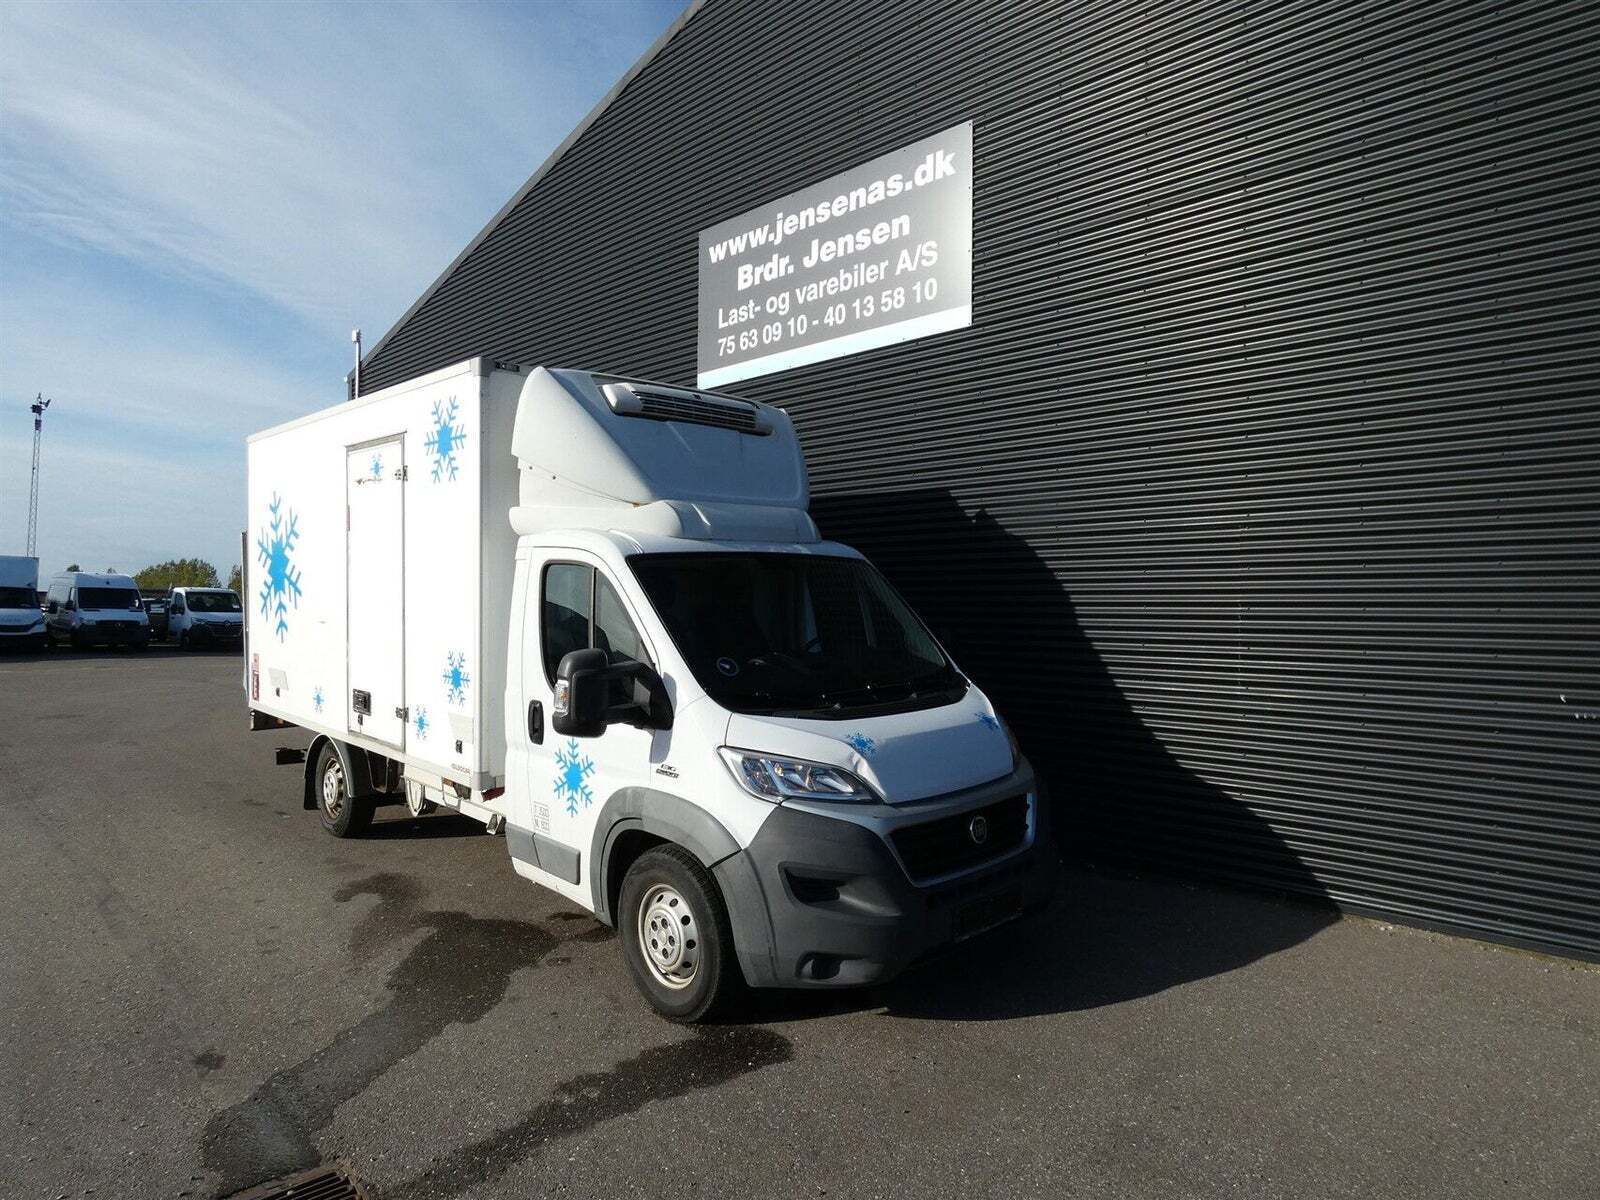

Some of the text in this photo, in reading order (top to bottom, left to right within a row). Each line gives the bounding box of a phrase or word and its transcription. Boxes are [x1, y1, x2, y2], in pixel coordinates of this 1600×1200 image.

[708, 149, 956, 264] www.jensenas.dk
[718, 240, 938, 329] Last- og varebiler A/S
[737, 214, 910, 291] Brdr. Jensen
[717, 335, 736, 357] 75
[739, 328, 759, 351] 63
[762, 321, 782, 345] 09
[787, 314, 808, 337] 10
[823, 303, 846, 327] 40
[852, 295, 875, 320] 13
[880, 286, 905, 312] 58
[912, 277, 938, 303] 10
